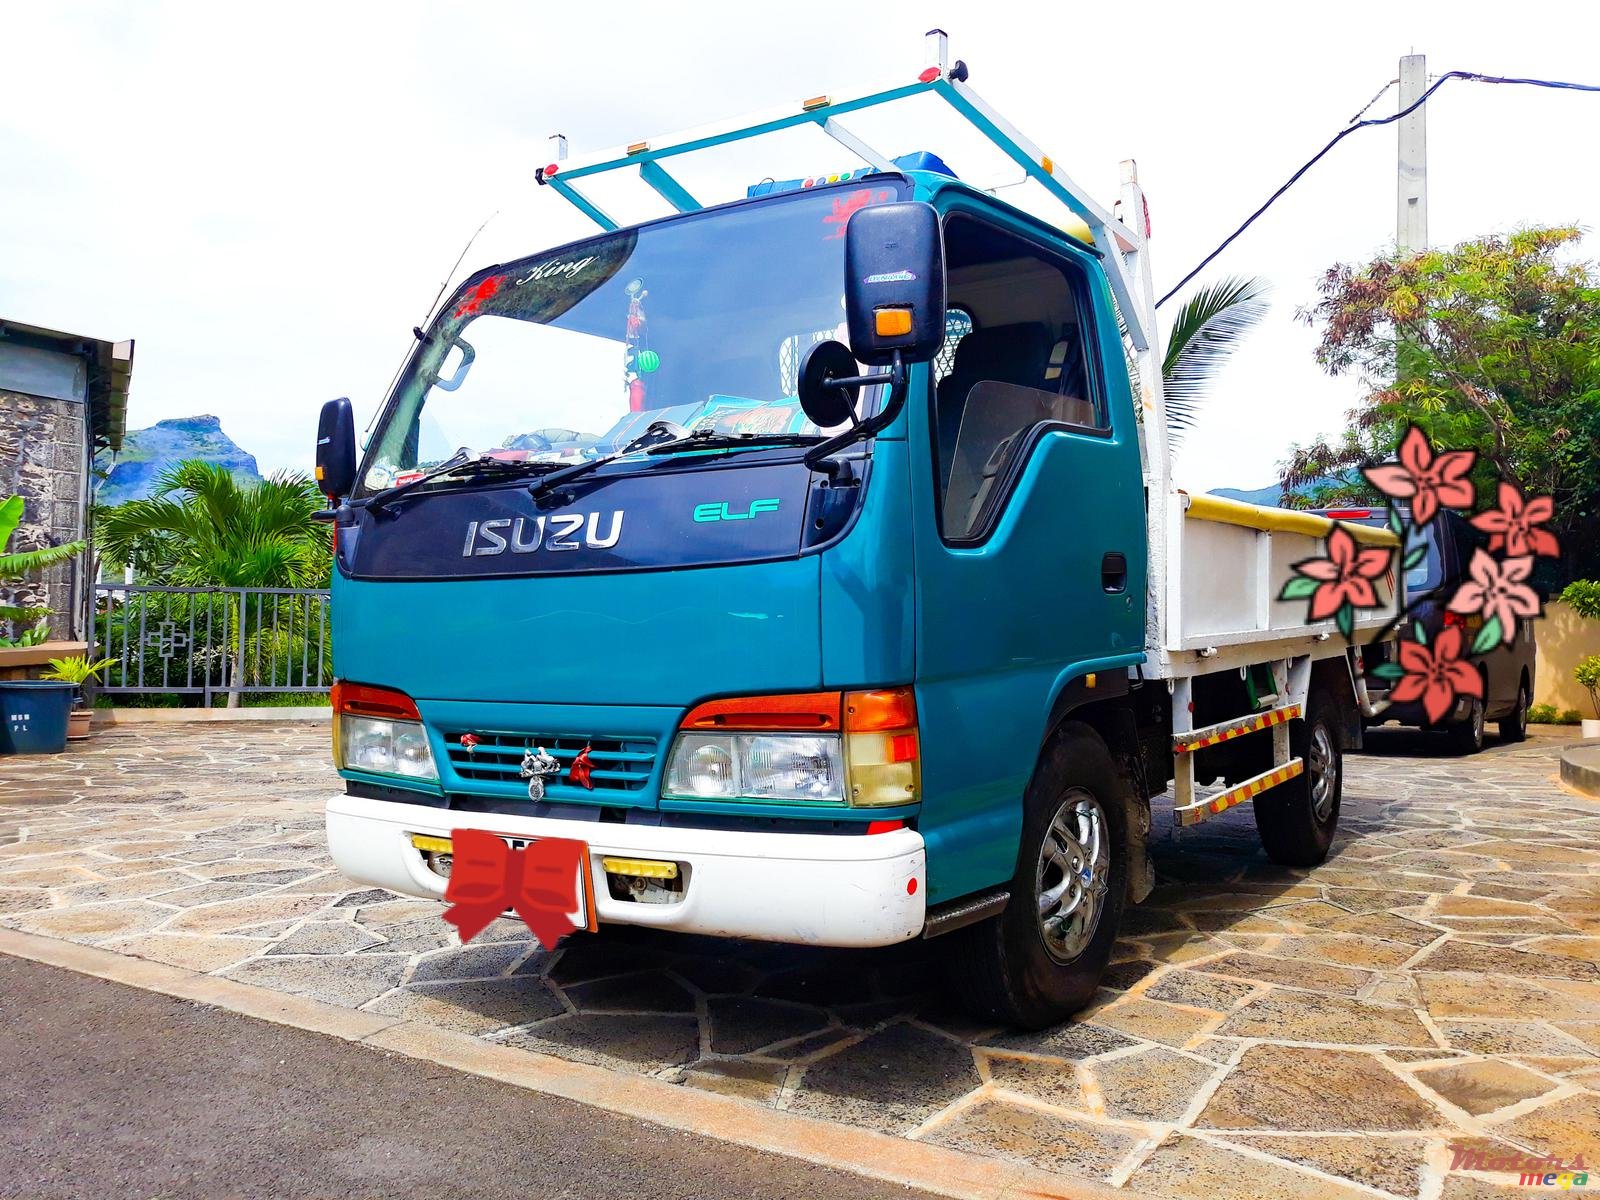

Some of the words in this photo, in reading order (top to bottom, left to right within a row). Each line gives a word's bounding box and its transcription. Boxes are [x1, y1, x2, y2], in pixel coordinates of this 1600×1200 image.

[516, 256, 600, 285] King
[693, 498, 780, 522] ELF
[463, 510, 624, 557] ISUZU
